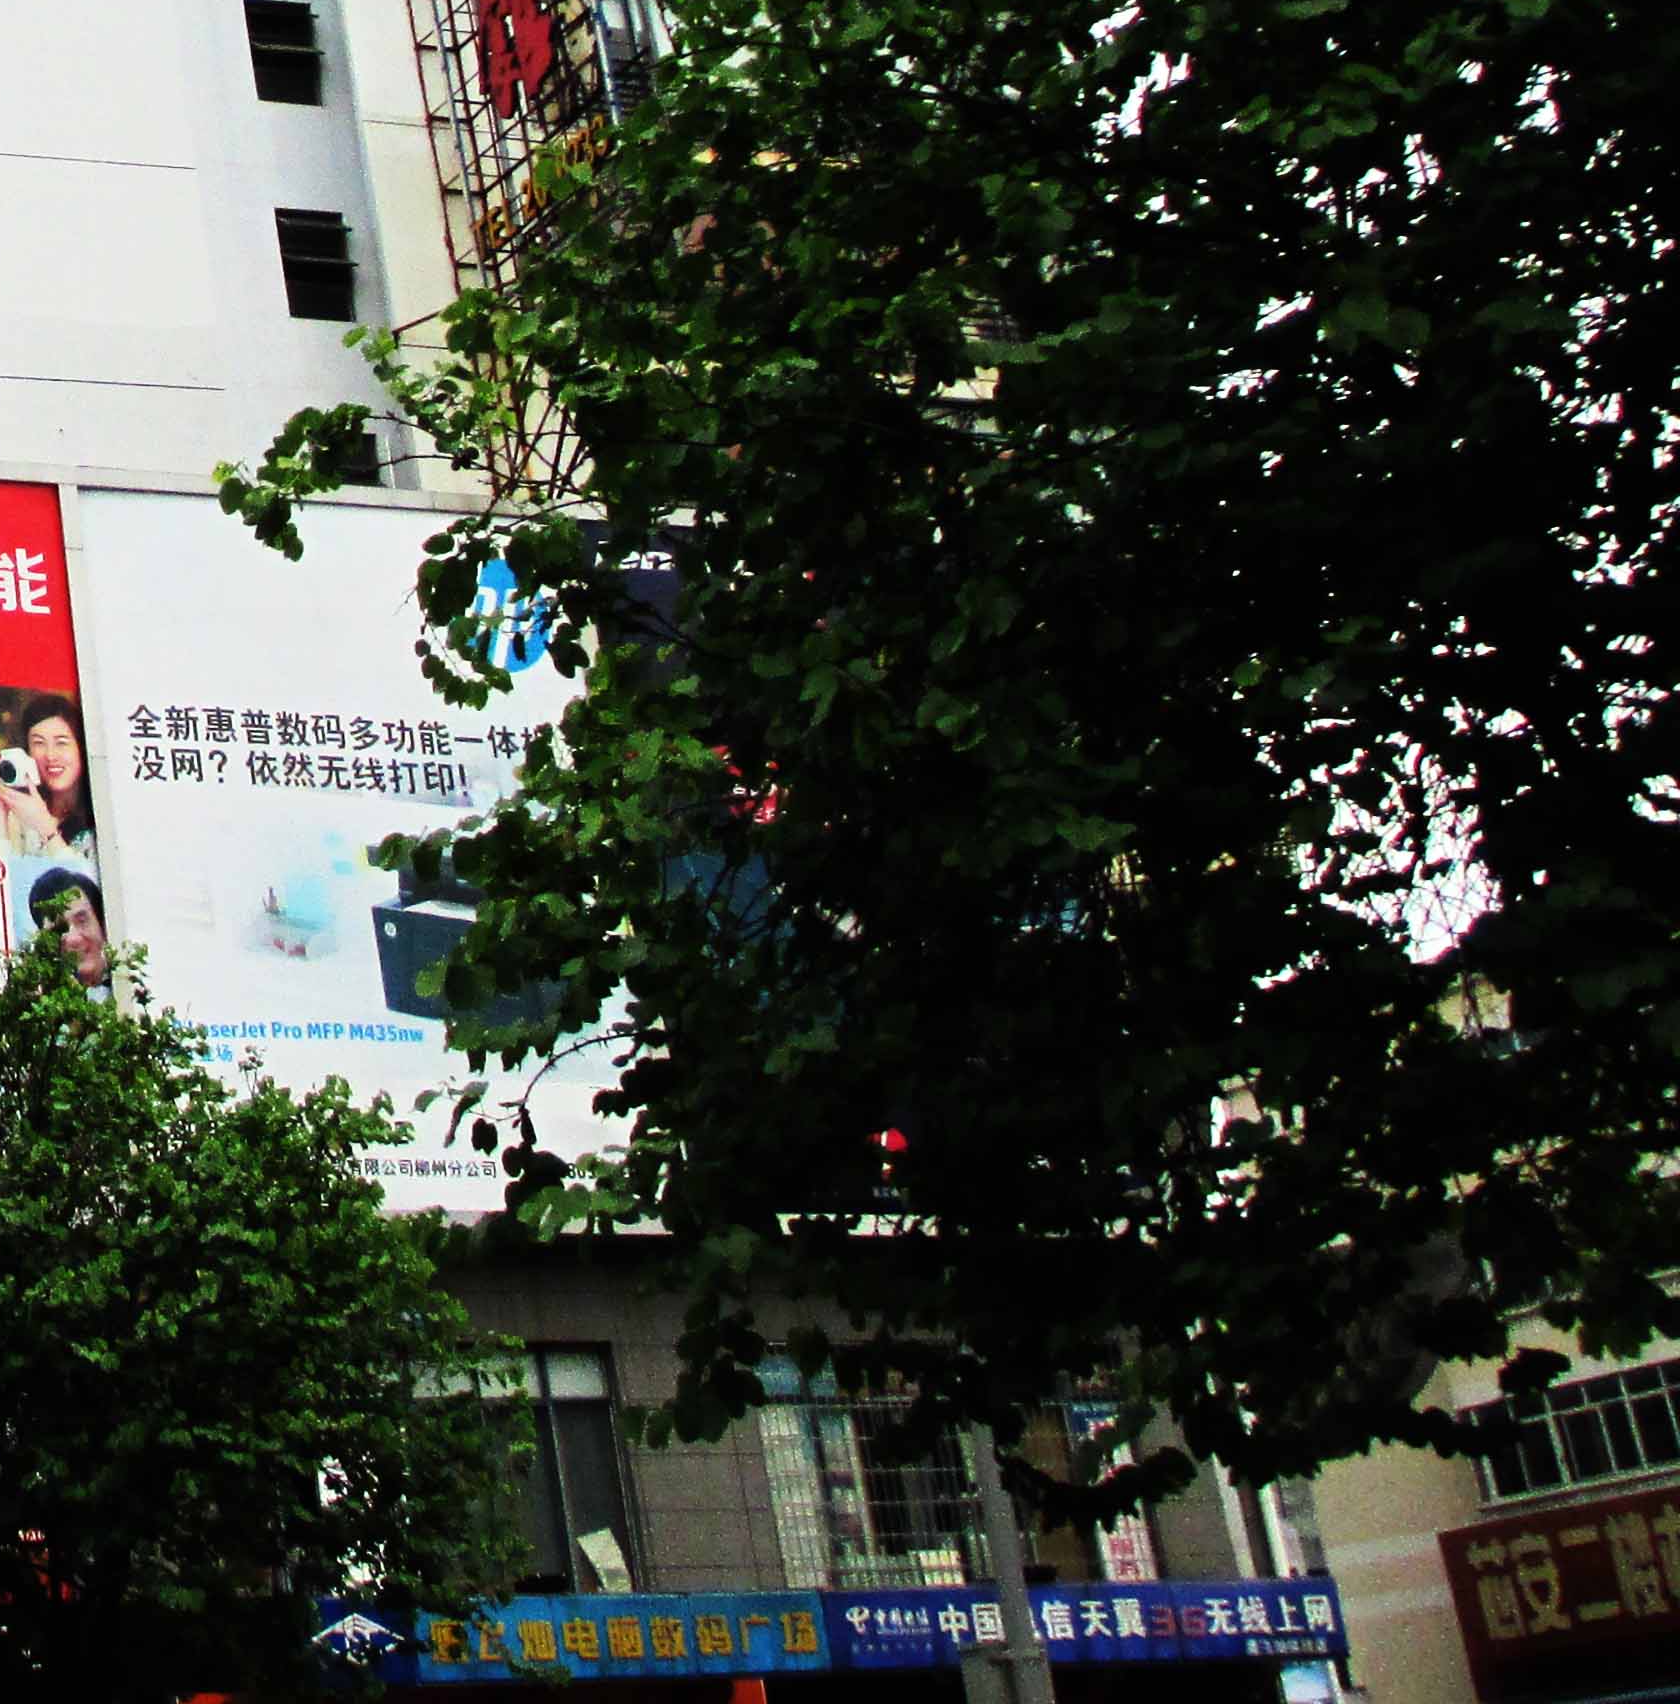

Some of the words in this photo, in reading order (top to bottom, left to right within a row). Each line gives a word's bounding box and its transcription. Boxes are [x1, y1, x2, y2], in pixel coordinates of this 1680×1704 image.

[271, 1021, 303, 1039] Pro
[307, 1022, 344, 1041] MFP
[349, 1023, 425, 1044] M435nw
